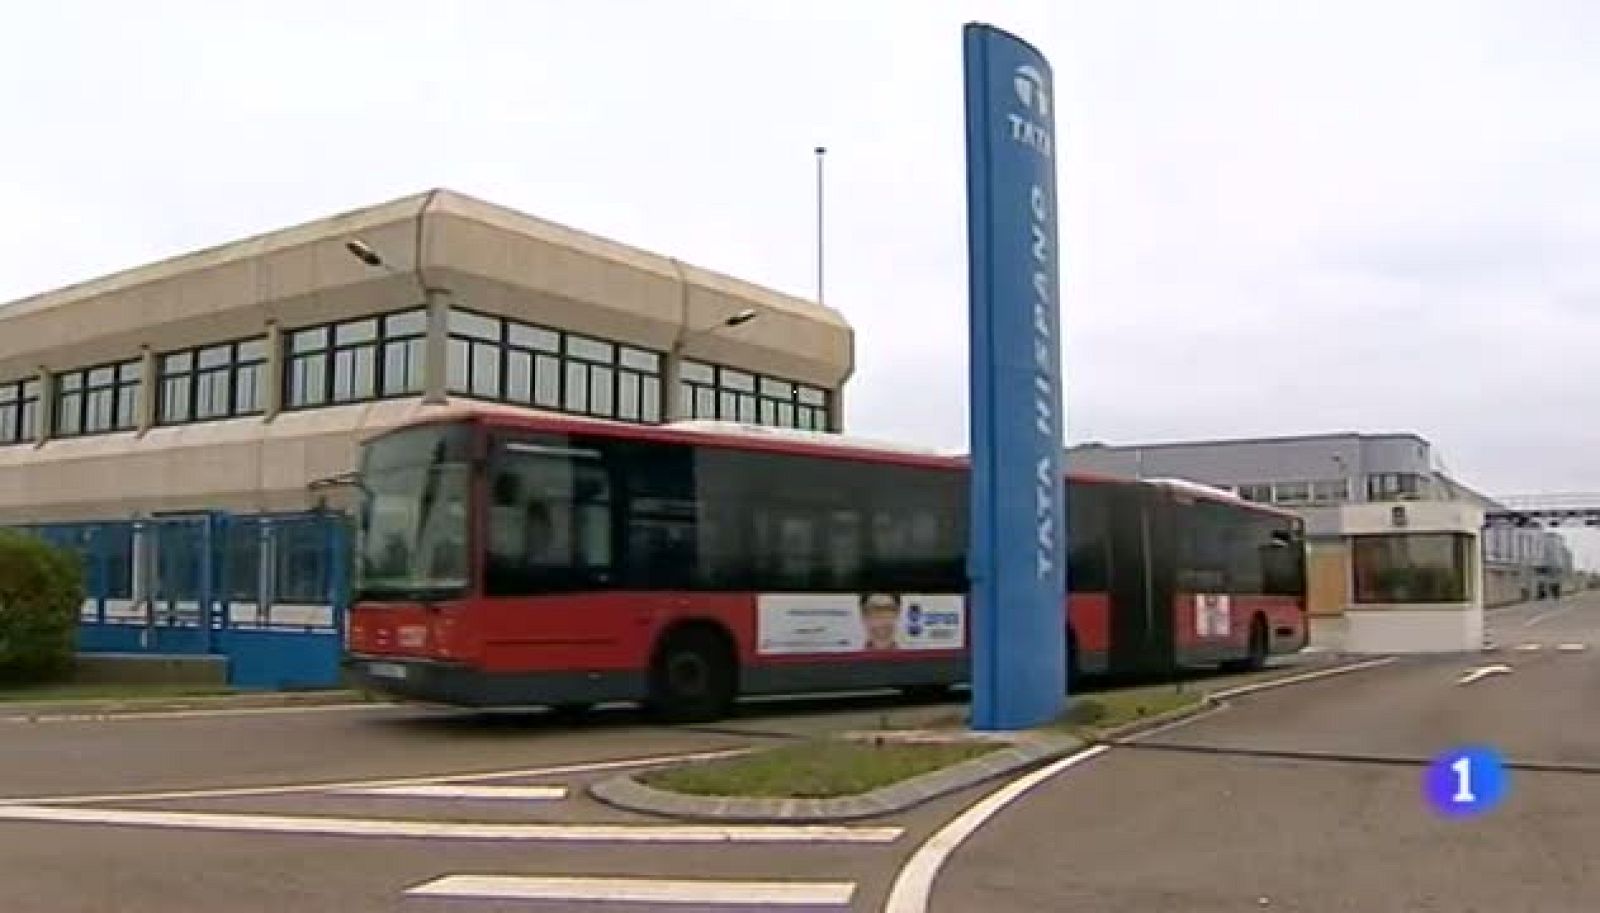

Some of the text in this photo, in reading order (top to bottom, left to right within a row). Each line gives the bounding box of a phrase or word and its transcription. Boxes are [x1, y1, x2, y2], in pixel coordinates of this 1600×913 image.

[1008, 113, 1051, 156] TATA
[1032, 184, 1052, 580] TATA HISPANO
